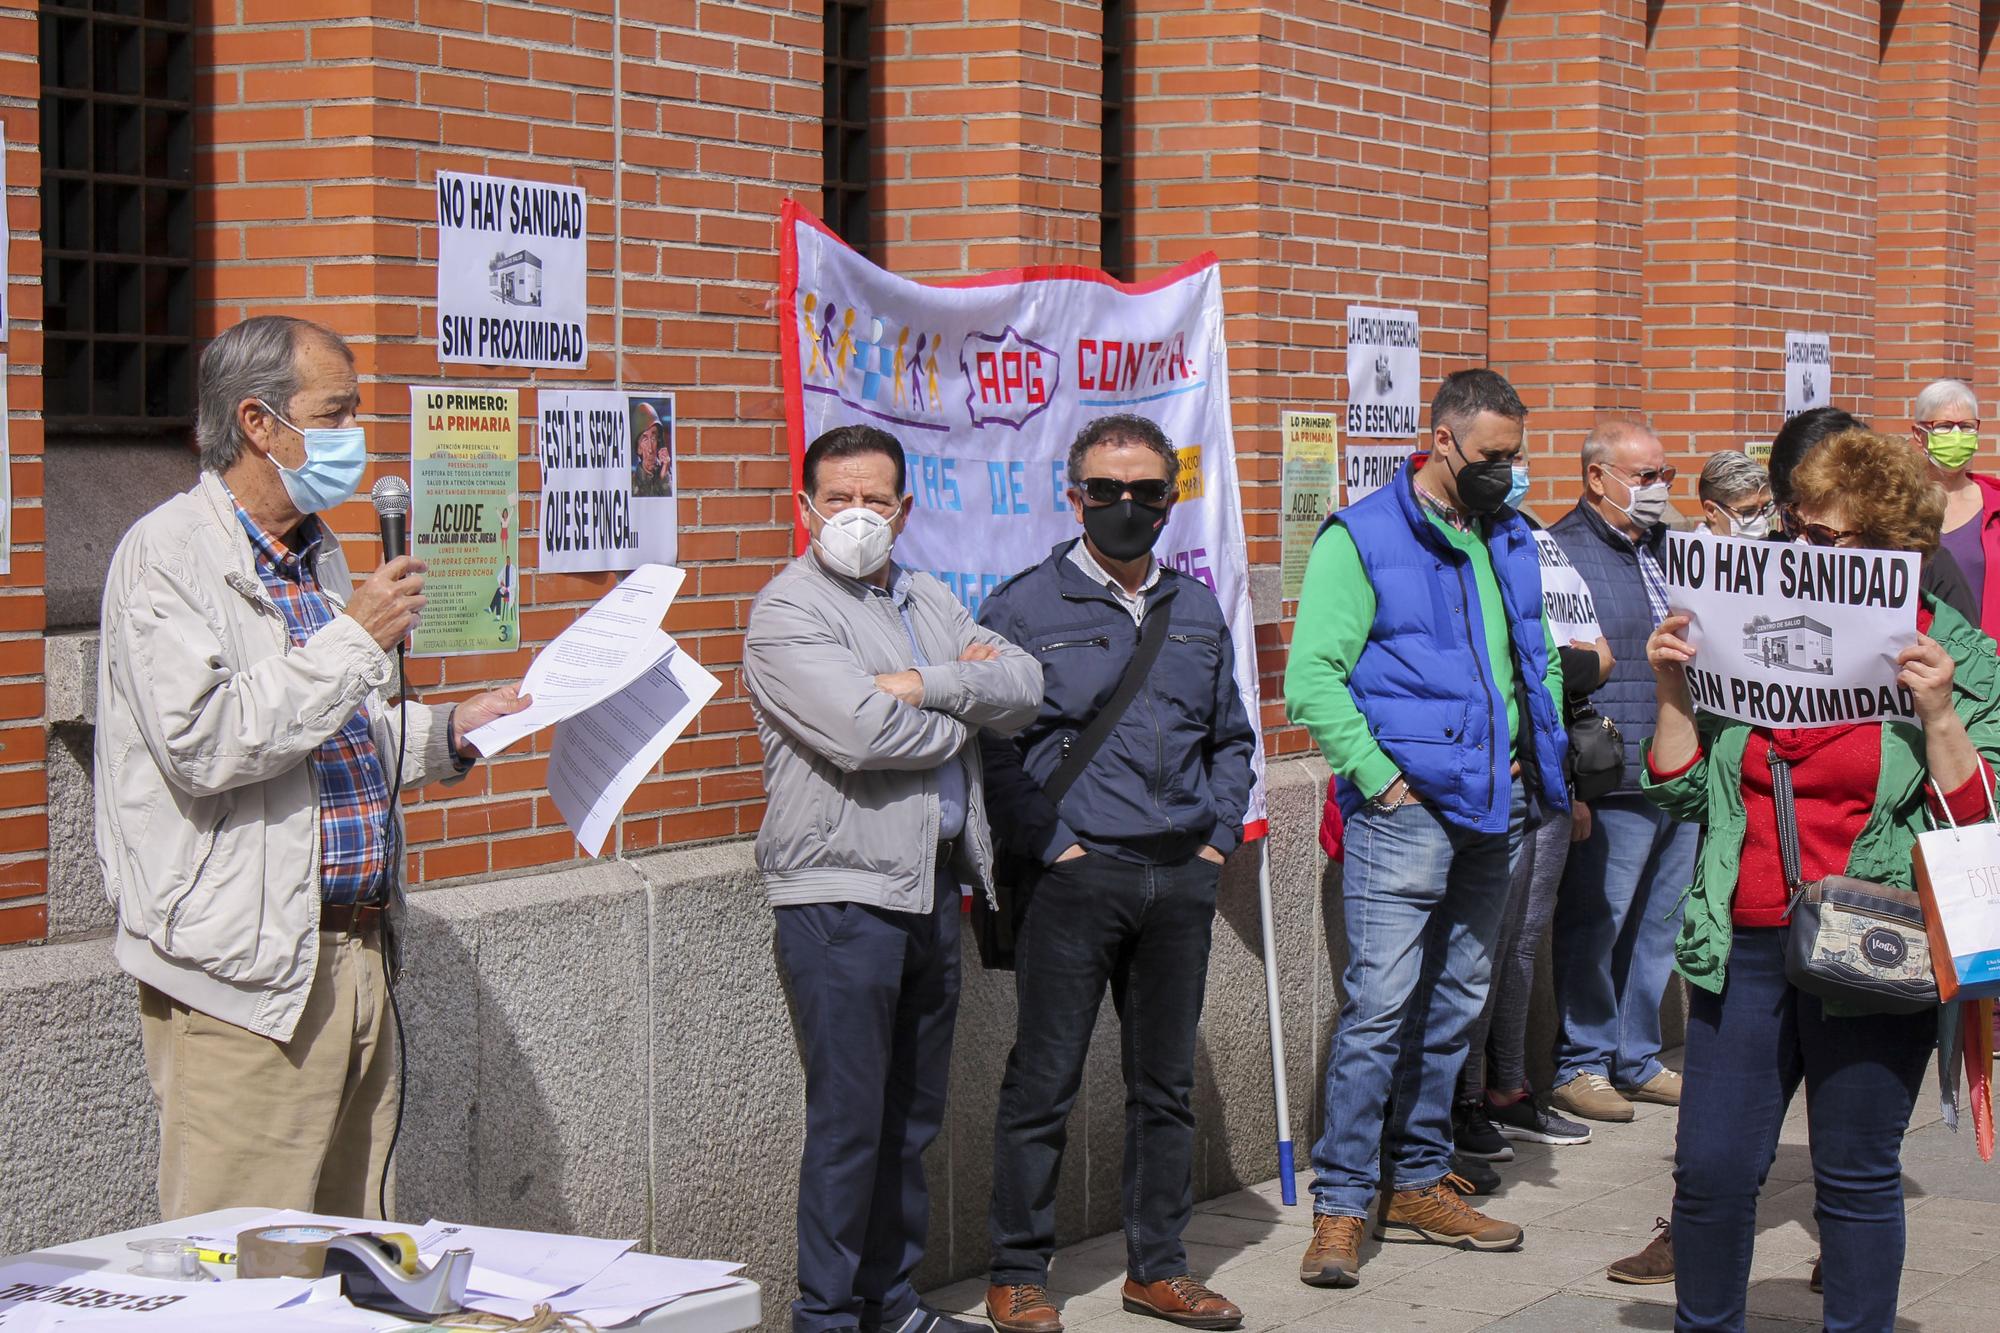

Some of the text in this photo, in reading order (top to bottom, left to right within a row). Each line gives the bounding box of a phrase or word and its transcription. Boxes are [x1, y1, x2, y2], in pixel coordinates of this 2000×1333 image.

[439, 177, 582, 240] NO HAY SANIDAD
[442, 314, 583, 362] SIN PROXIMIDAD
[1078, 331, 1197, 392] CONTRA:
[976, 351, 1045, 404] APG
[428, 394, 507, 411] LO PRIMERO:
[428, 415, 511, 432] LA PRIMARIA
[1291, 416, 1299, 427] LO
[1349, 404, 1415, 434] ES ESENCIAL
[541, 395, 624, 485] ¿ESTÁ EL SESPA?
[1291, 431, 1332, 443] LA PRIMARIA
[906, 453, 962, 512] TAS
[987, 460, 1030, 515] DE
[1347, 455, 1360, 488] LO
[432, 503, 484, 533] ACUDE
[1292, 493, 1319, 514] ACUDE
[546, 489, 639, 557] QUE SE PONGA...
[418, 533, 430, 544] CON
[431, 533, 439, 544] LA
[440, 533, 459, 544] SALUD
[460, 533, 469, 544] NO
[470, 533, 477, 543] SE
[442, 557, 461, 565] HORAS
[448, 569, 471, 577] SEVERO
[473, 569, 494, 577] OCHOA
[1668, 537, 1909, 609] NO HAY SANIDAD
[1757, 623, 1776, 631] CENTRO
[1784, 619, 1800, 627] SALUD
[1685, 665, 1916, 723] SIN PROXIMIDAD
[1967, 865, 2000, 898] ESTE
[121, 1295, 188, 1312] ES
